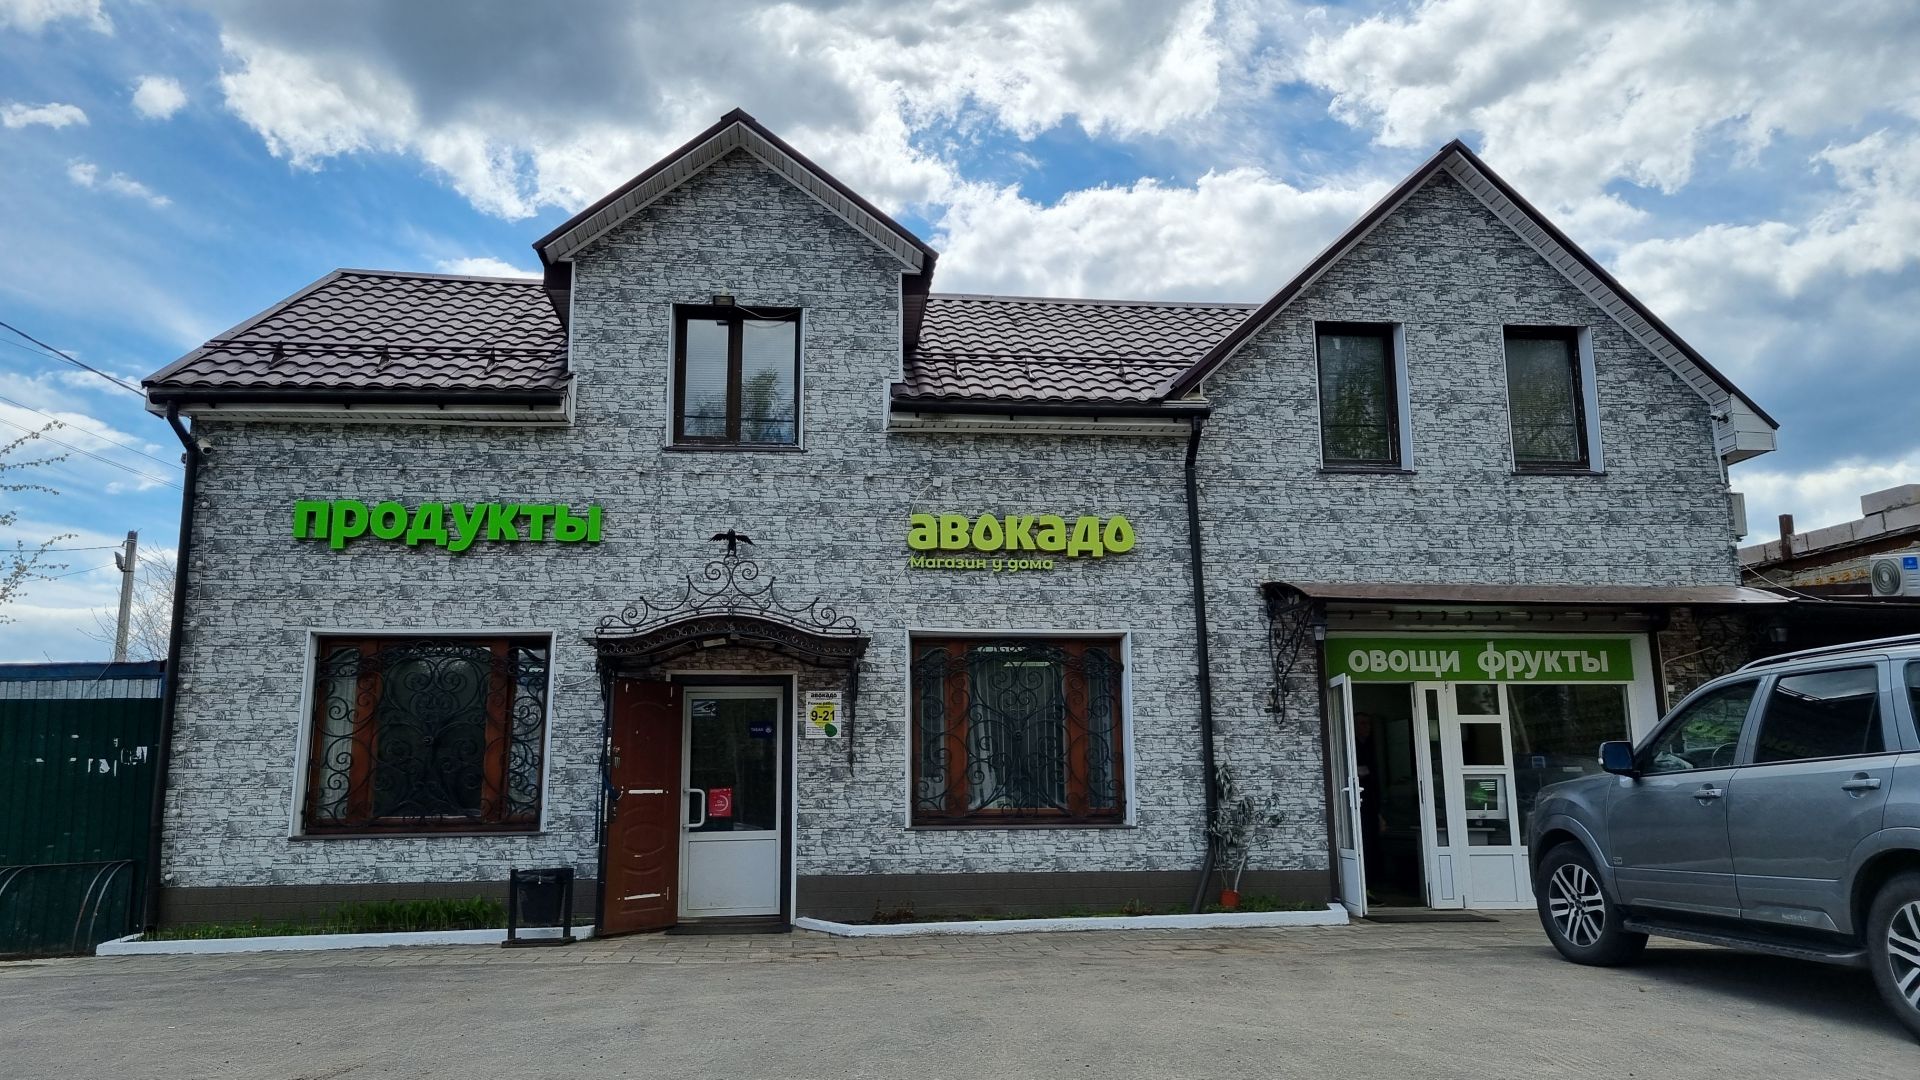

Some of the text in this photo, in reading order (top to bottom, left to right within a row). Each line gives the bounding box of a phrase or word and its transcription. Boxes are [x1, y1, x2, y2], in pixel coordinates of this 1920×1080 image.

[292, 499, 601, 552] продукты
[907, 513, 1136, 557] авокадо
[910, 555, 1054, 572] Магазин у дома
[1348, 641, 1609, 680] овощи фрукты
[811, 710, 835, 721] 9-21
